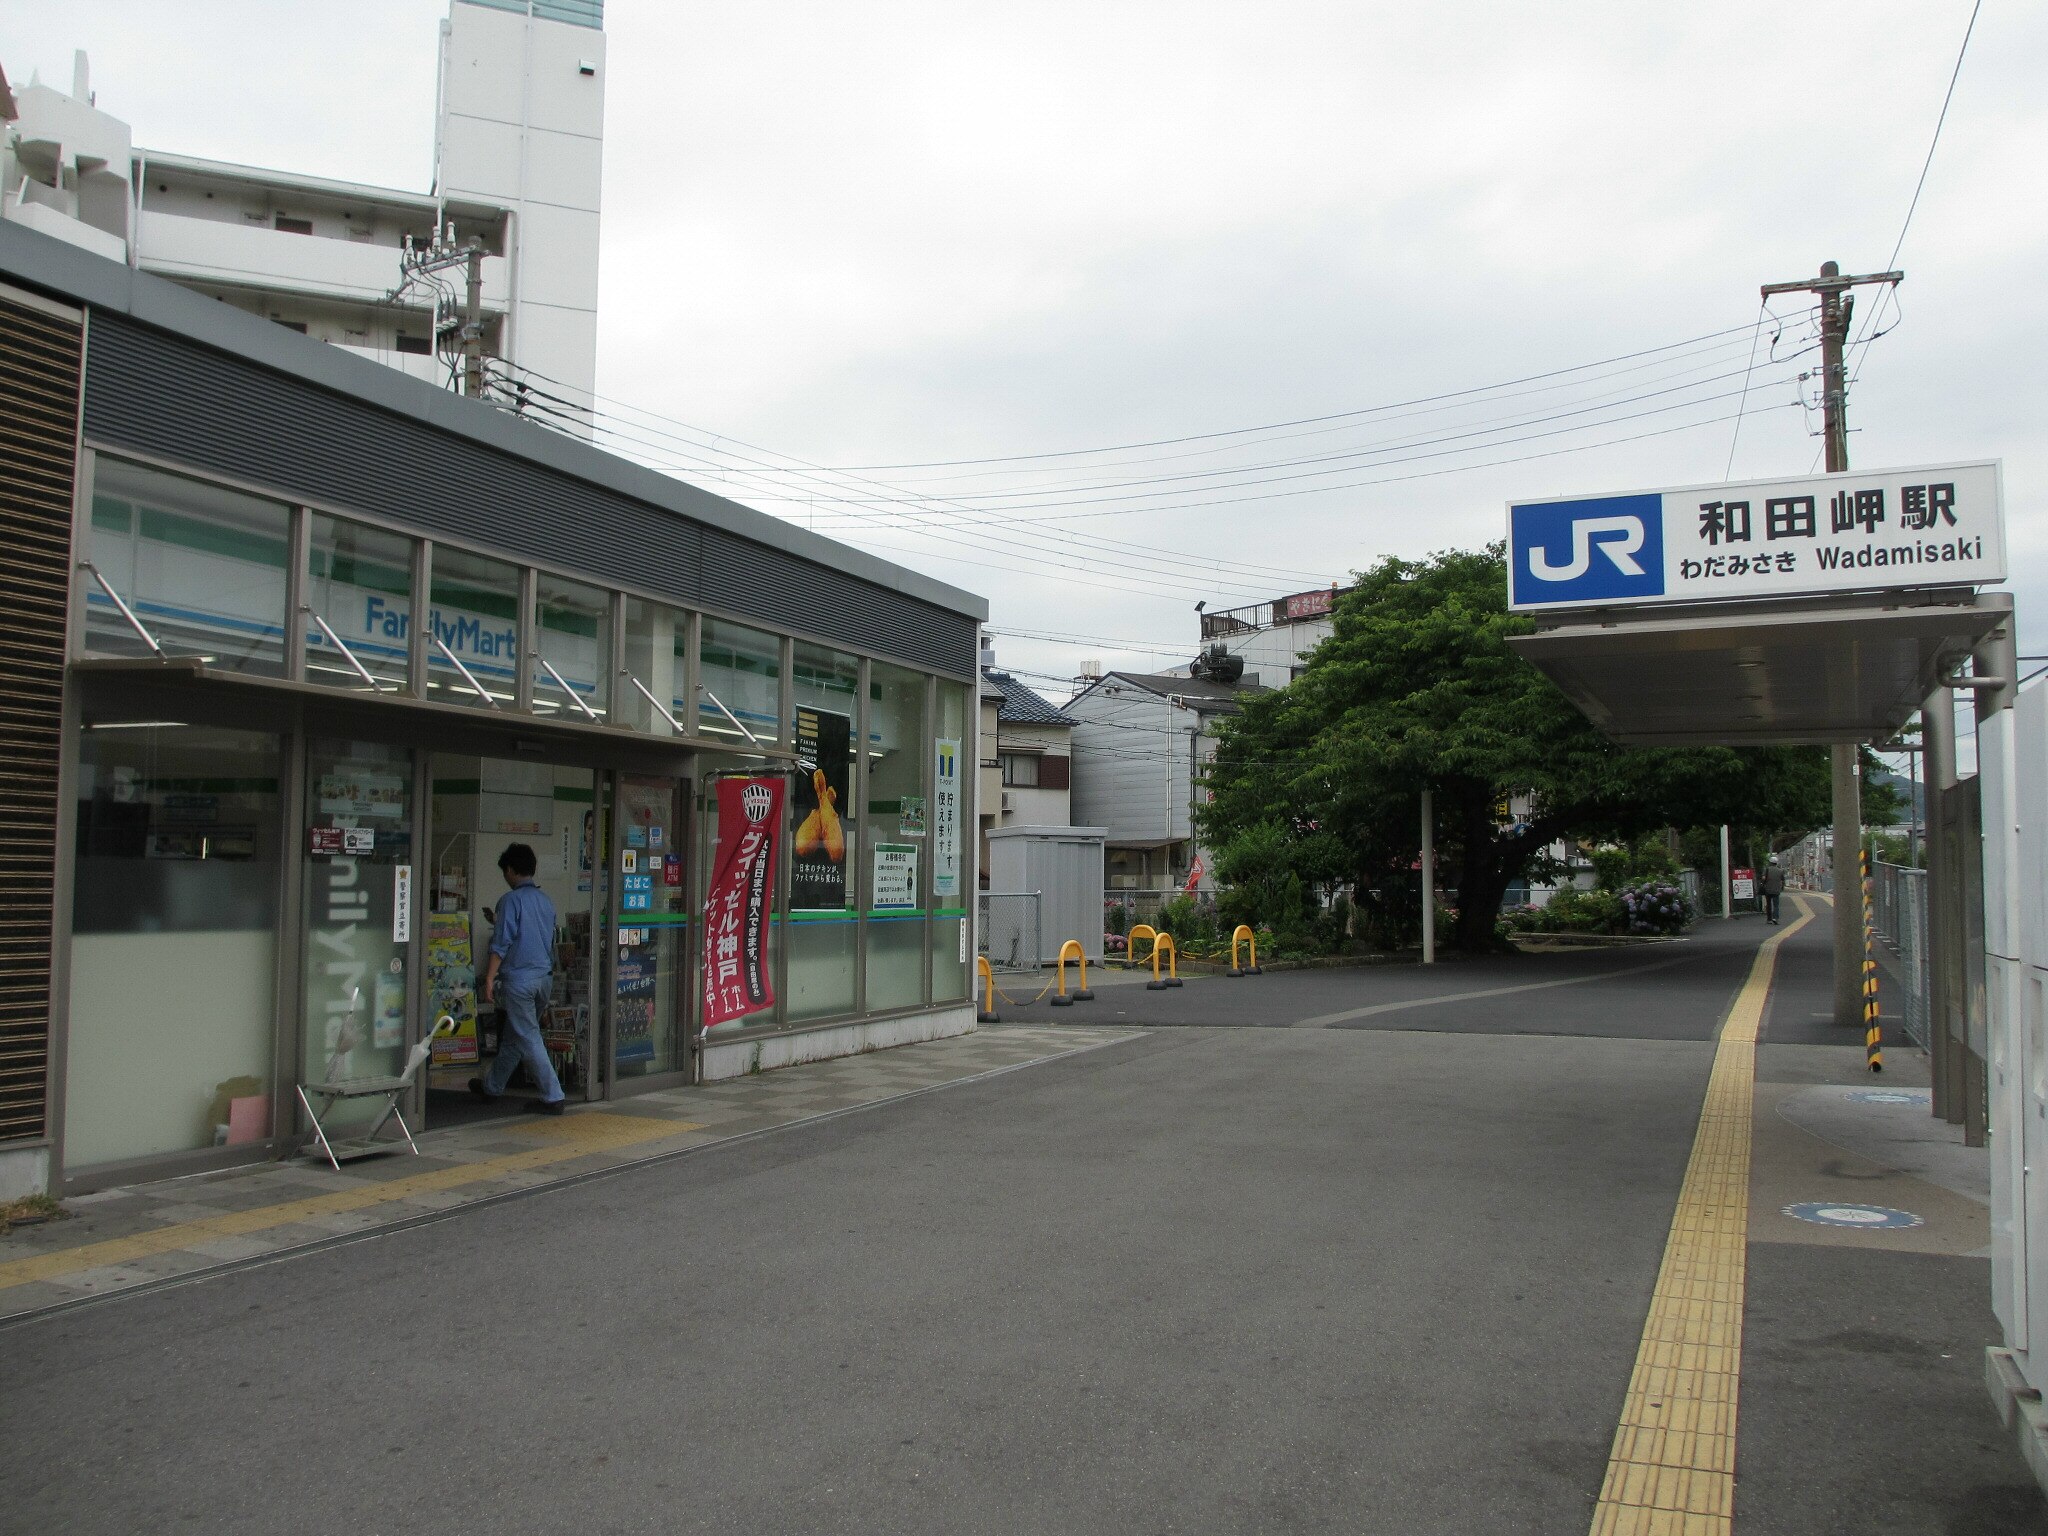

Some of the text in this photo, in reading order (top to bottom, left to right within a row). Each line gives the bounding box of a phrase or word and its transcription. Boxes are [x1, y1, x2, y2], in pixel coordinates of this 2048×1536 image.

[1698, 482, 1958, 546] 和田岬駅
[1528, 515, 1647, 582] JR
[1680, 535, 1982, 580] わだみさき Wadamisaki
[938, 791, 946, 856] 使えます。
[795, 873, 843, 884] ファミマから変わる。
[799, 863, 839, 874] 日本のチキンが、
[625, 877, 650, 889] たばこ
[628, 895, 646, 907] お酒
[717, 831, 763, 985] ヴィッセル神戸
[720, 987, 733, 1014] ゲーム
[731, 985, 745, 1011] ホーム
